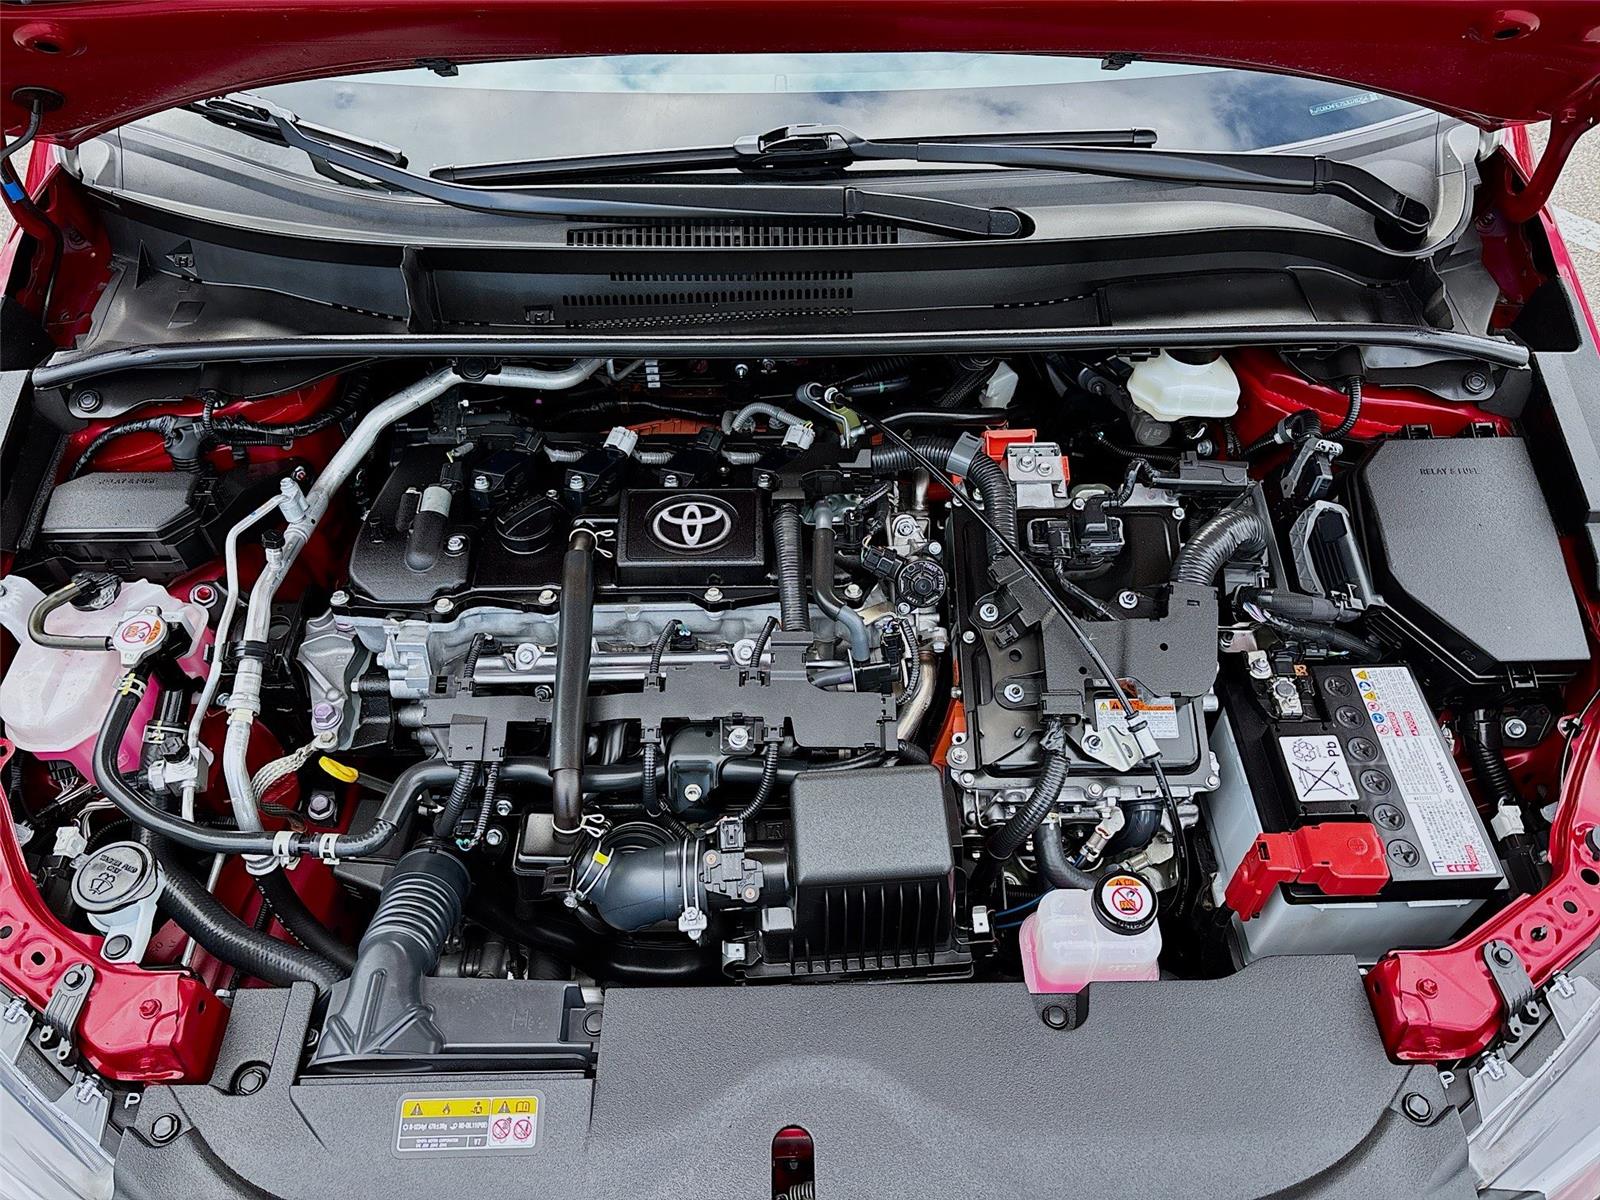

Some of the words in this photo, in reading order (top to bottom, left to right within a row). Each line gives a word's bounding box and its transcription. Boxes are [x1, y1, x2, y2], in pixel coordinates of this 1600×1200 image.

[1419, 467, 1447, 476] RELAY
[1326, 741, 1340, 757] Pb
[1439, 1070, 1455, 1090] P
[124, 1092, 141, 1110] P
